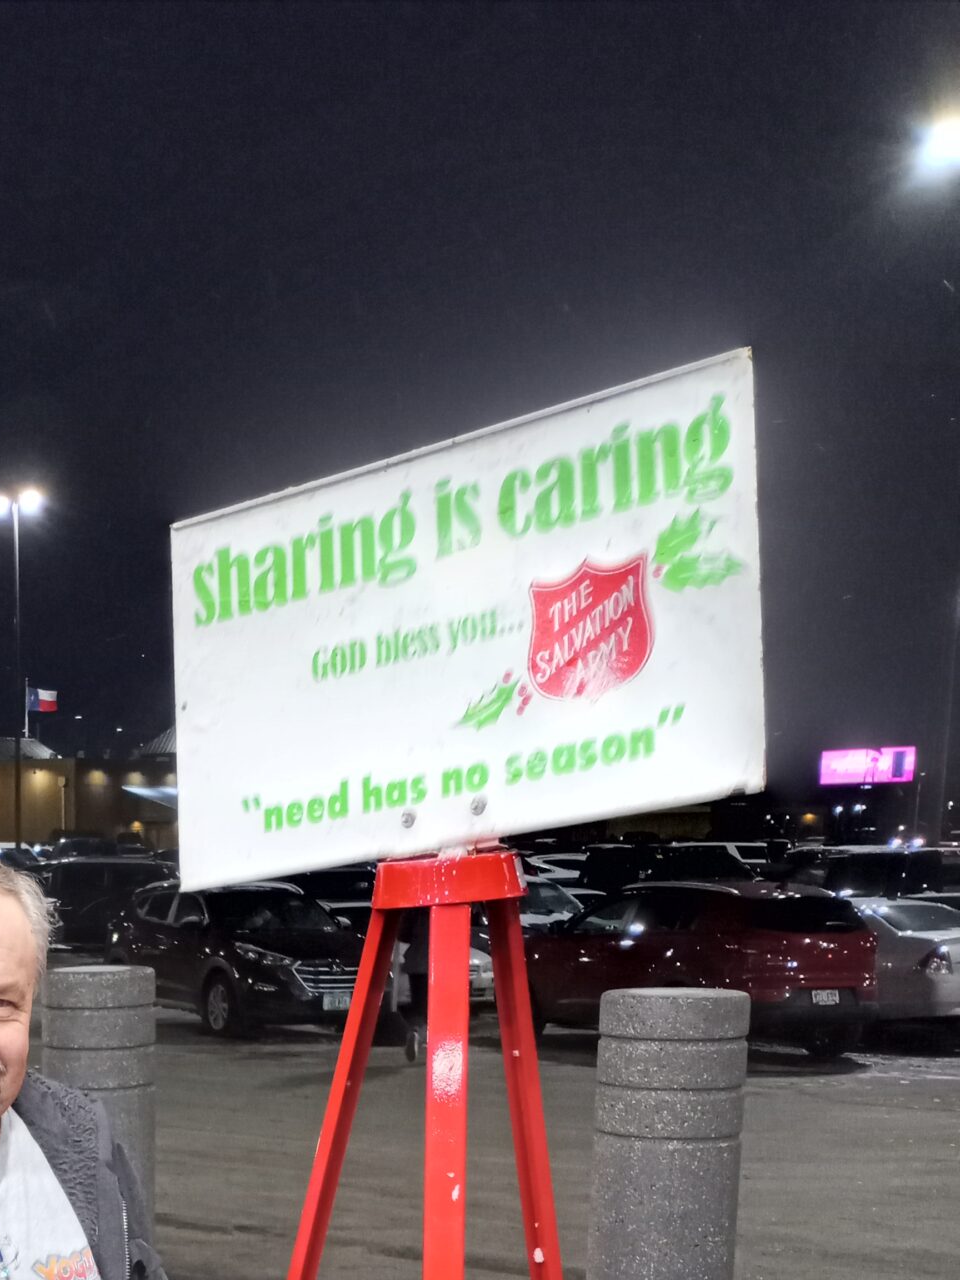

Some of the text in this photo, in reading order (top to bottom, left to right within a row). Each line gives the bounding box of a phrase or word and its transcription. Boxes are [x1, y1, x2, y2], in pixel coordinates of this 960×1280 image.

[193, 393, 734, 627] sharing is caring
[536, 575, 635, 684] SALVATION
[549, 580, 594, 632] THE
[374, 623, 440, 668] bless
[568, 617, 633, 681] ARMY
[361, 773, 428, 813] has
[441, 761, 490, 797] no
